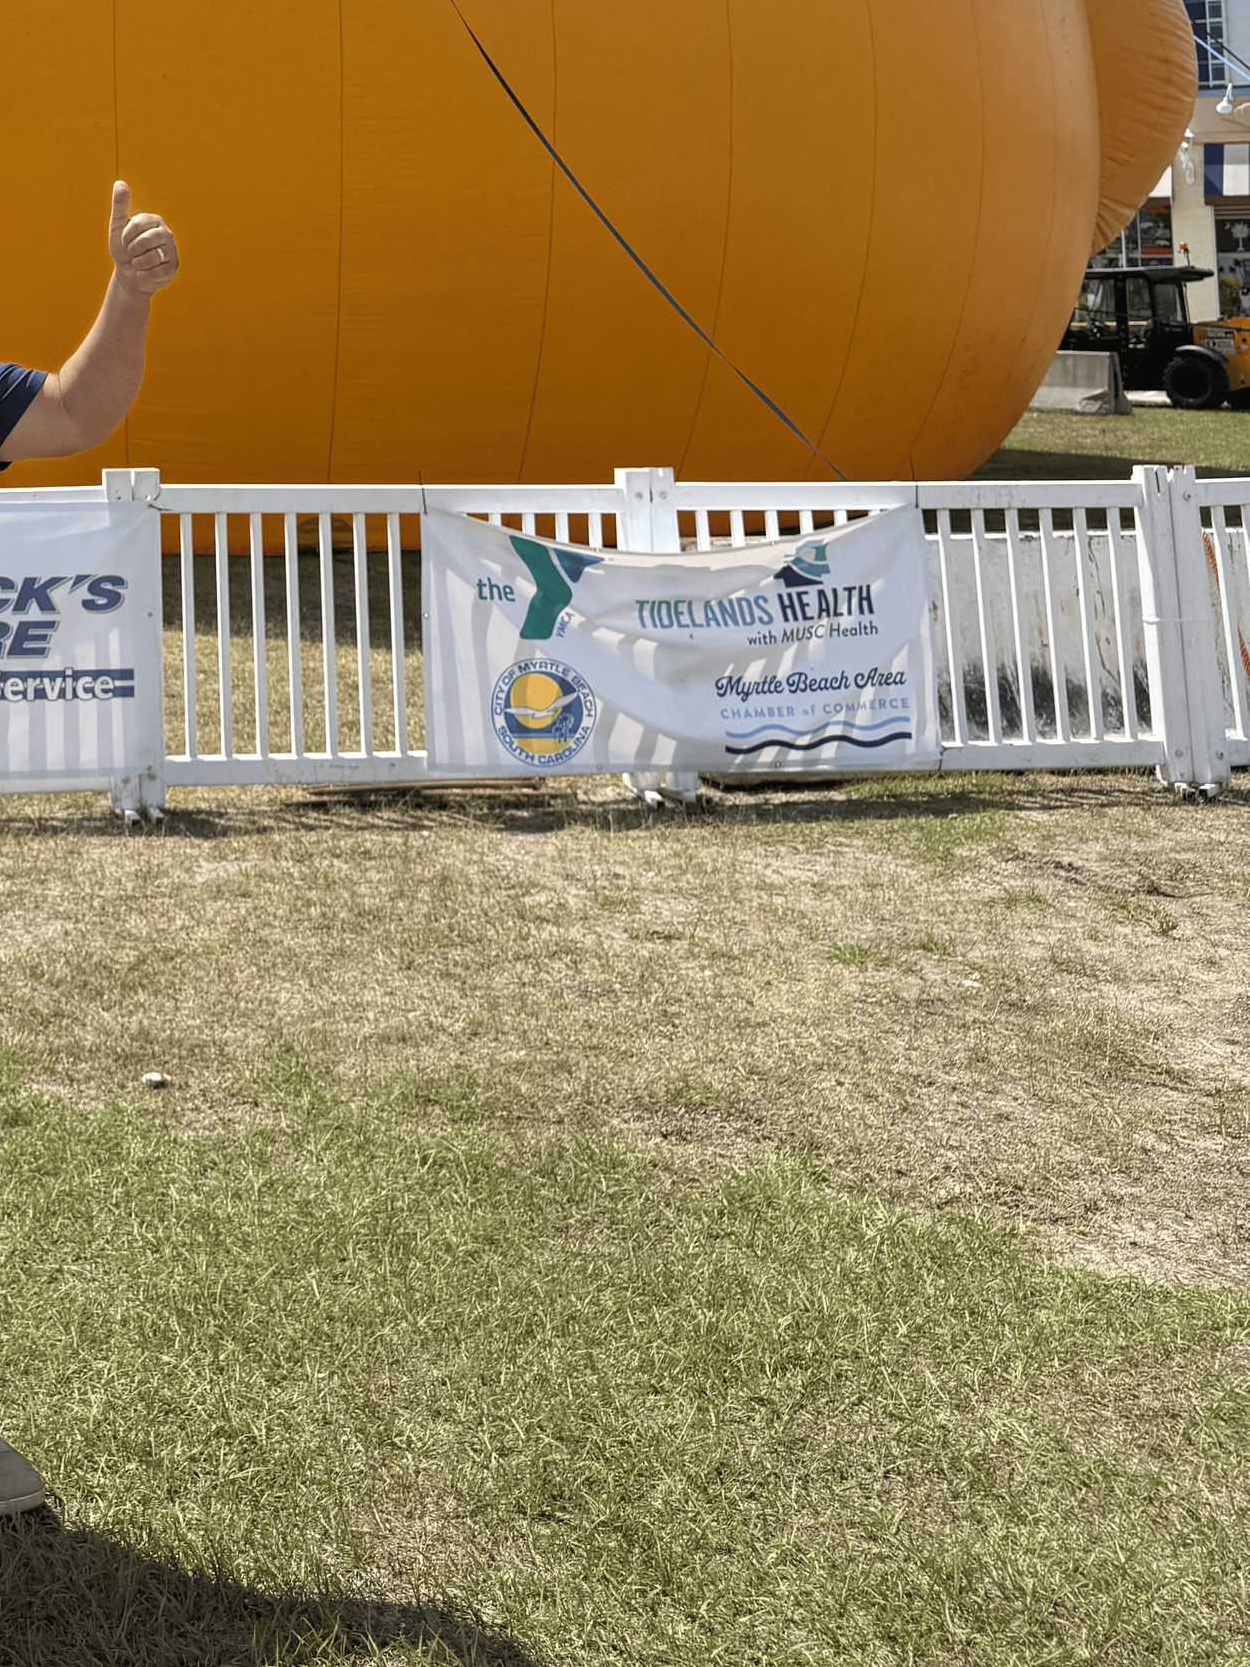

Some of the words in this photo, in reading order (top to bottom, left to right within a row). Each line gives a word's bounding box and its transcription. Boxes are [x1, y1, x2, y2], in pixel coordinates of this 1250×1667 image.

[476, 576, 516, 602] the
[635, 595, 774, 629] TIDELANDS
[777, 584, 874, 623] HEALTH
[555, 611, 575, 638] YMCA
[747, 630, 777, 646] with
[781, 624, 825, 644] MUSC
[829, 620, 879, 639] Health
[494, 685, 505, 716] CITY
[502, 669, 516, 686] OF
[517, 661, 571, 677] MYRTLE
[570, 675, 593, 718] BEACH
[715, 675, 785, 703] Myrtle
[785, 670, 851, 694] Beach
[853, 667, 907, 689] Area
[720, 706, 795, 721] CHAMBER
[802, 704, 816, 716] of
[823, 697, 910, 715] COMMERCE
[498, 725, 535, 762] SOUTH
[538, 725, 590, 764] CAROLINA
